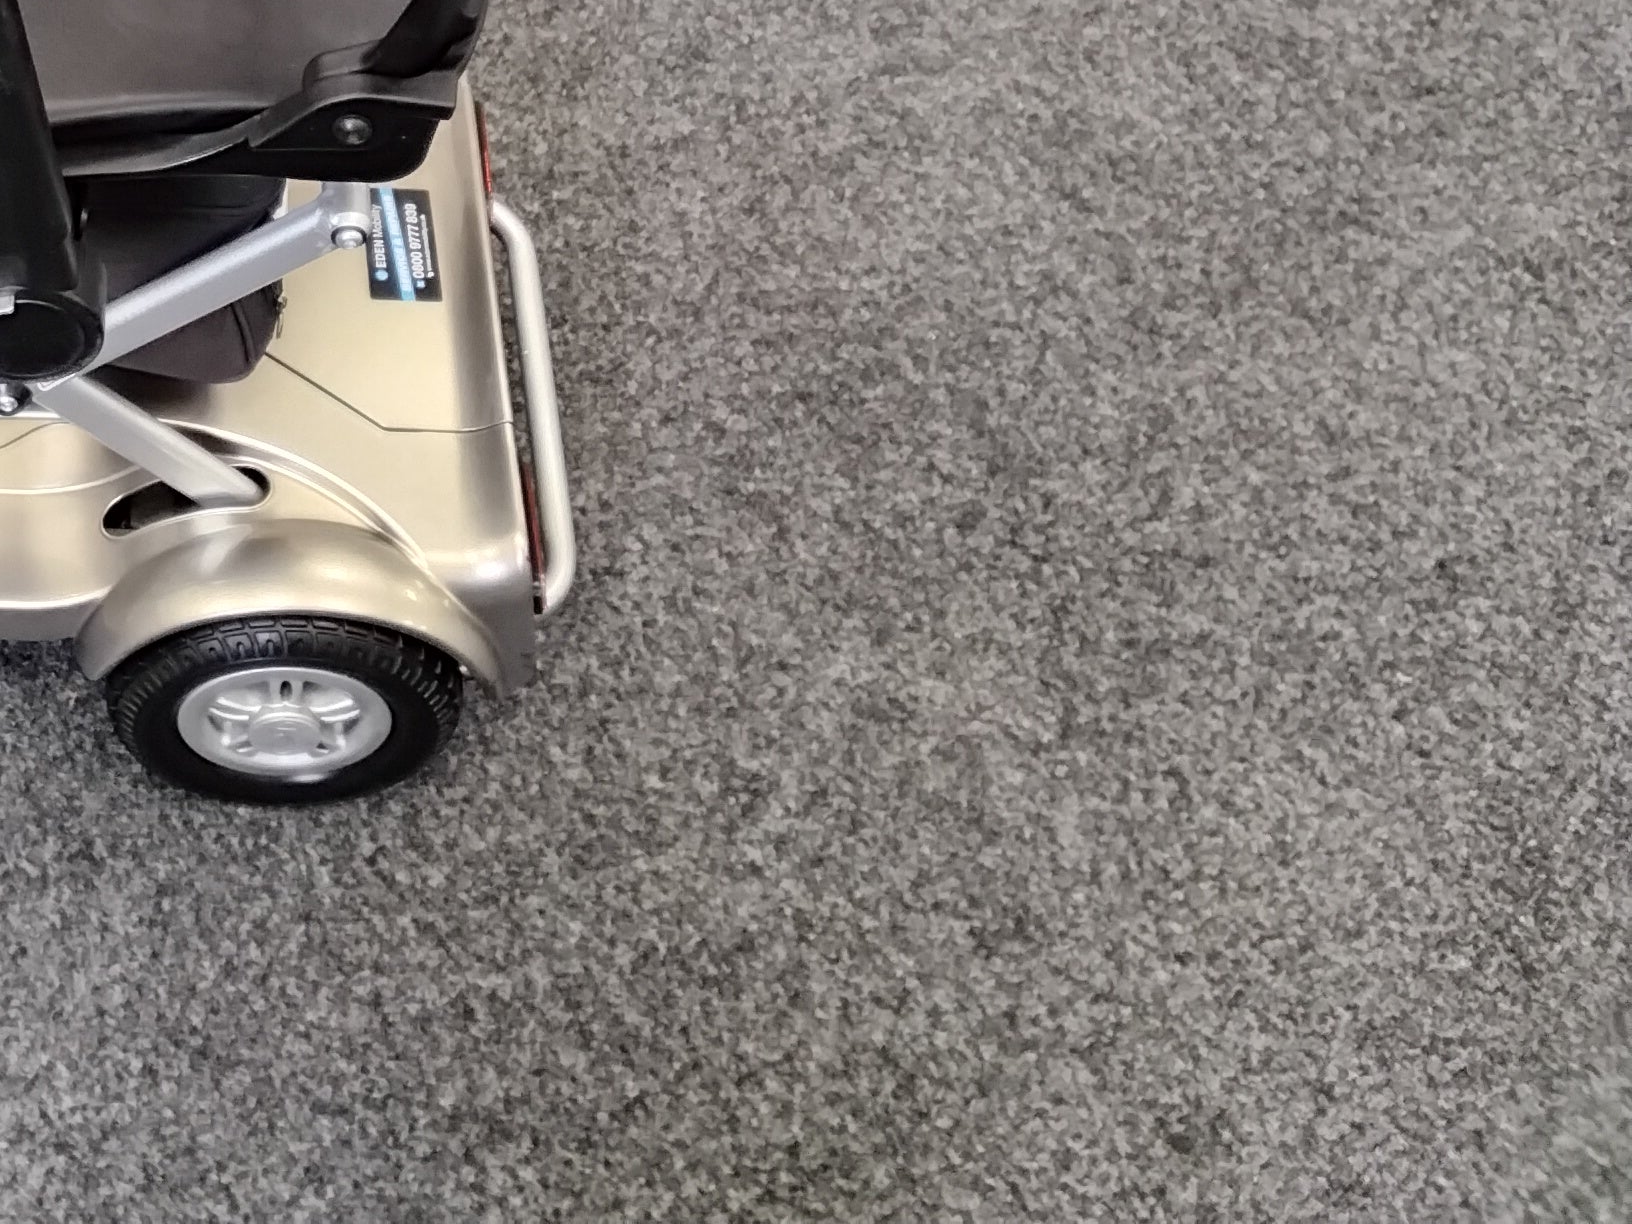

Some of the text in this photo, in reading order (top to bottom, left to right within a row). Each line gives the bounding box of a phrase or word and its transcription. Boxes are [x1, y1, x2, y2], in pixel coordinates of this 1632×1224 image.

[371, 204, 387, 268] EDEN Mobility
[411, 251, 425, 279] 0800
